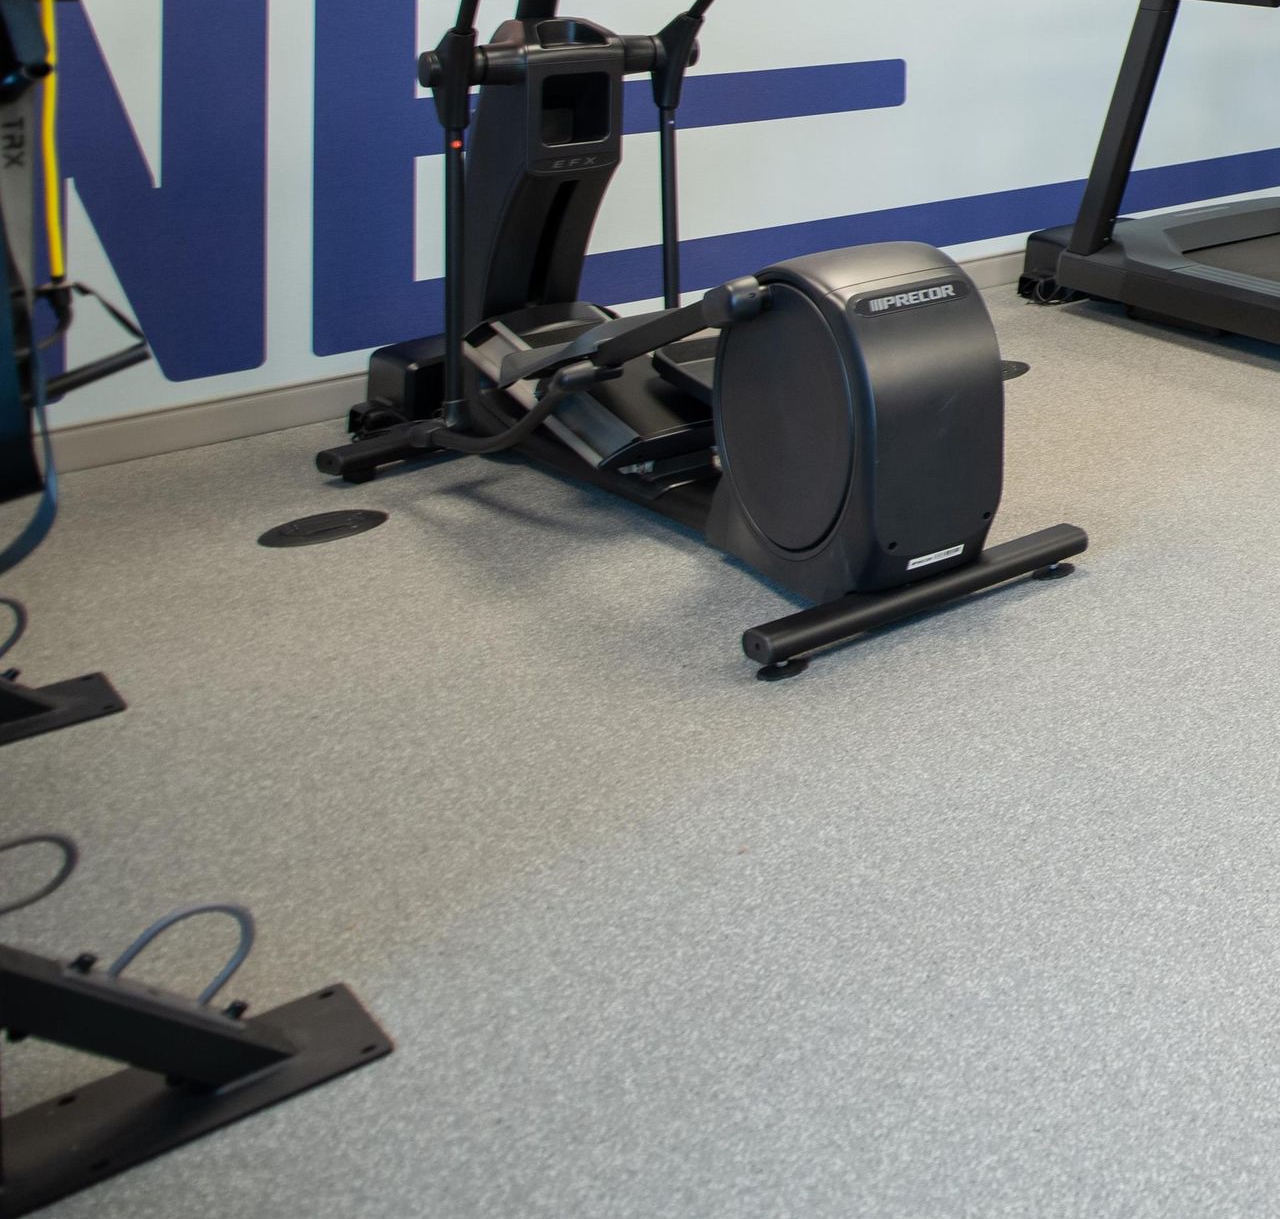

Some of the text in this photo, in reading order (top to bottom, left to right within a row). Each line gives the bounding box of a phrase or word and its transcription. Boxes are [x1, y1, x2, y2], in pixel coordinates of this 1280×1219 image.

[1, 116, 25, 169] TRX
[553, 156, 598, 169] EFX
[873, 284, 956, 311] PRECOR
